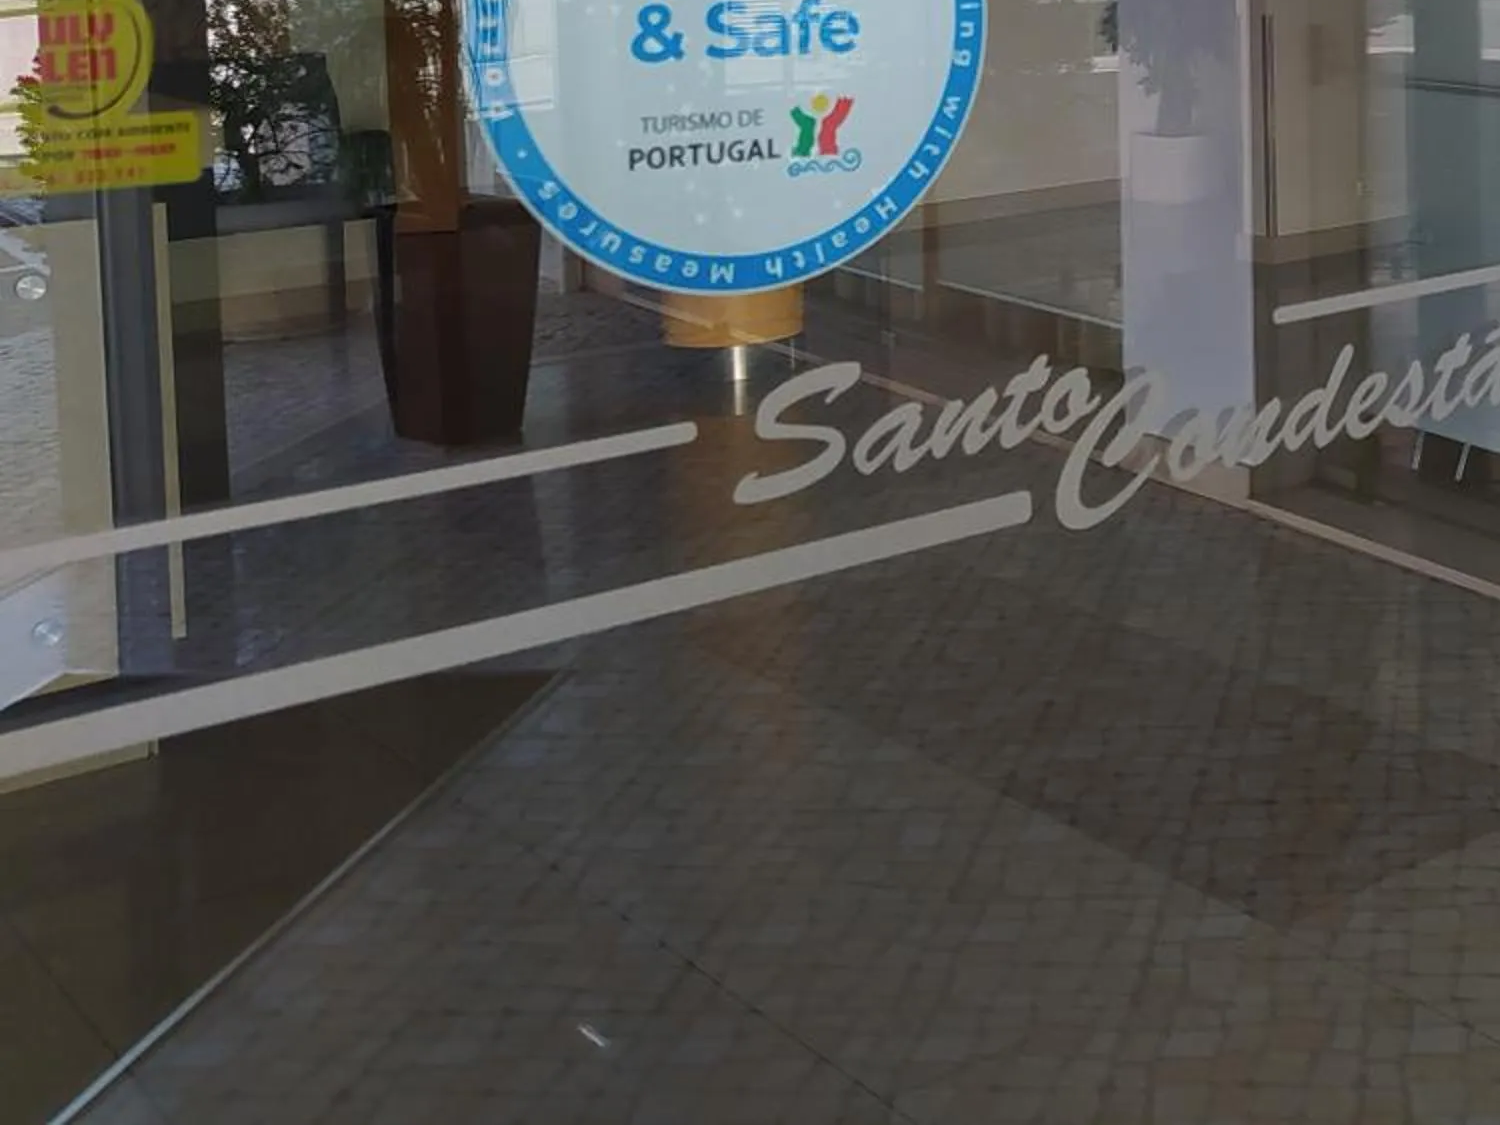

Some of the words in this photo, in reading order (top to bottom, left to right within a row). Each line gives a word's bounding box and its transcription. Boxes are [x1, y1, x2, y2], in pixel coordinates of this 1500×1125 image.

[630, 3, 685, 62] &
[629, 138, 781, 172] PORTUGAL
[640, 111, 732, 135] TURISMO
[738, 108, 764, 128] DE
[908, 94, 962, 180] with
[538, 179, 735, 285] Measures
[765, 200, 899, 280] Health
[734, 353, 1102, 505] Santo
